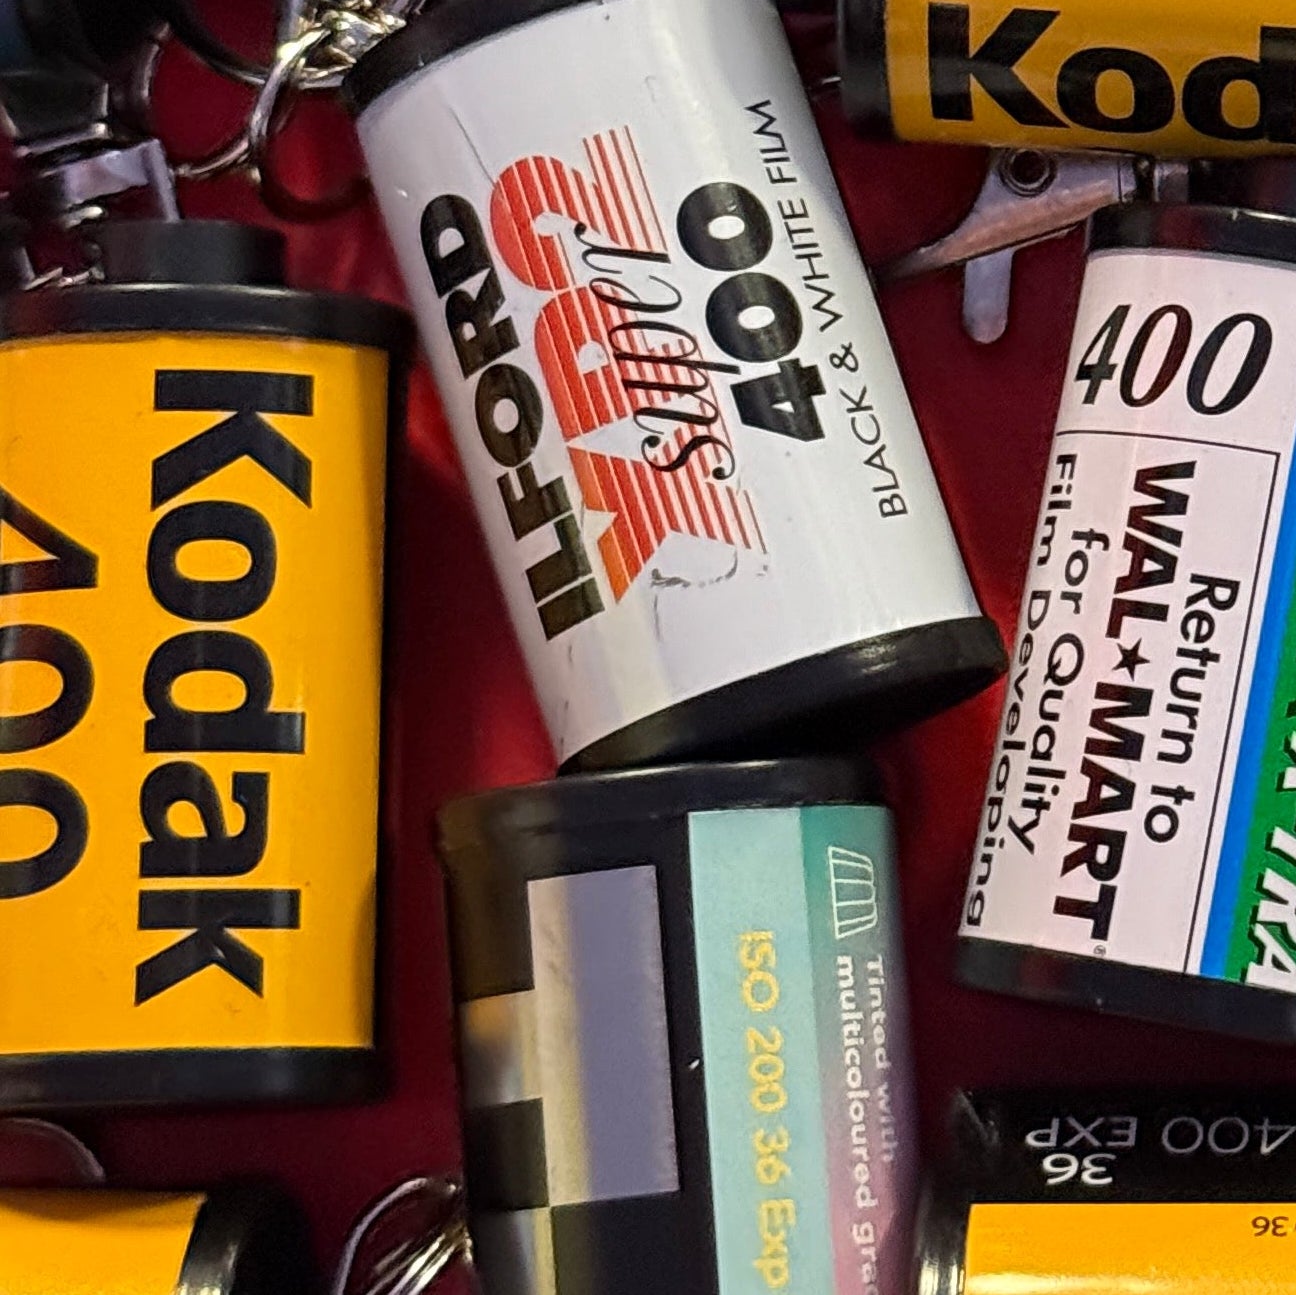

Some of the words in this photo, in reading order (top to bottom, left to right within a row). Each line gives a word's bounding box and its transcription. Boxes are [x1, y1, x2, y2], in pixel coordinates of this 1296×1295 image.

[743, 98, 799, 186] FILM
[675, 180, 828, 443] 400
[782, 196, 845, 333] WHITE
[573, 221, 742, 482] super
[828, 341, 860, 374] &
[1073, 302, 1275, 417] 400
[418, 192, 606, 642] ILFORD
[838, 384, 909, 519] BLACK
[1036, 453, 1078, 567] Film
[1060, 528, 1111, 616] for
[133, 367, 315, 1007] Kodak
[1156, 573, 1242, 765] Return
[966, 589, 1051, 928] Developing
[1006, 632, 1085, 856] Quality
[1143, 784, 1196, 844] to
[738, 929, 781, 1013] ISO
[867, 954, 892, 1071] Tinted
[746, 1026, 789, 1115] 200
[836, 954, 880, 1209] multicoloured
[752, 1126, 792, 1186] 36
[1023, 1114, 1138, 1149] EXP
[1041, 1152, 1115, 1187] 36
[1160, 1114, 1296, 1156] 400
[752, 1198, 797, 1291] Exp
[1250, 1214, 1290, 1238] 36
